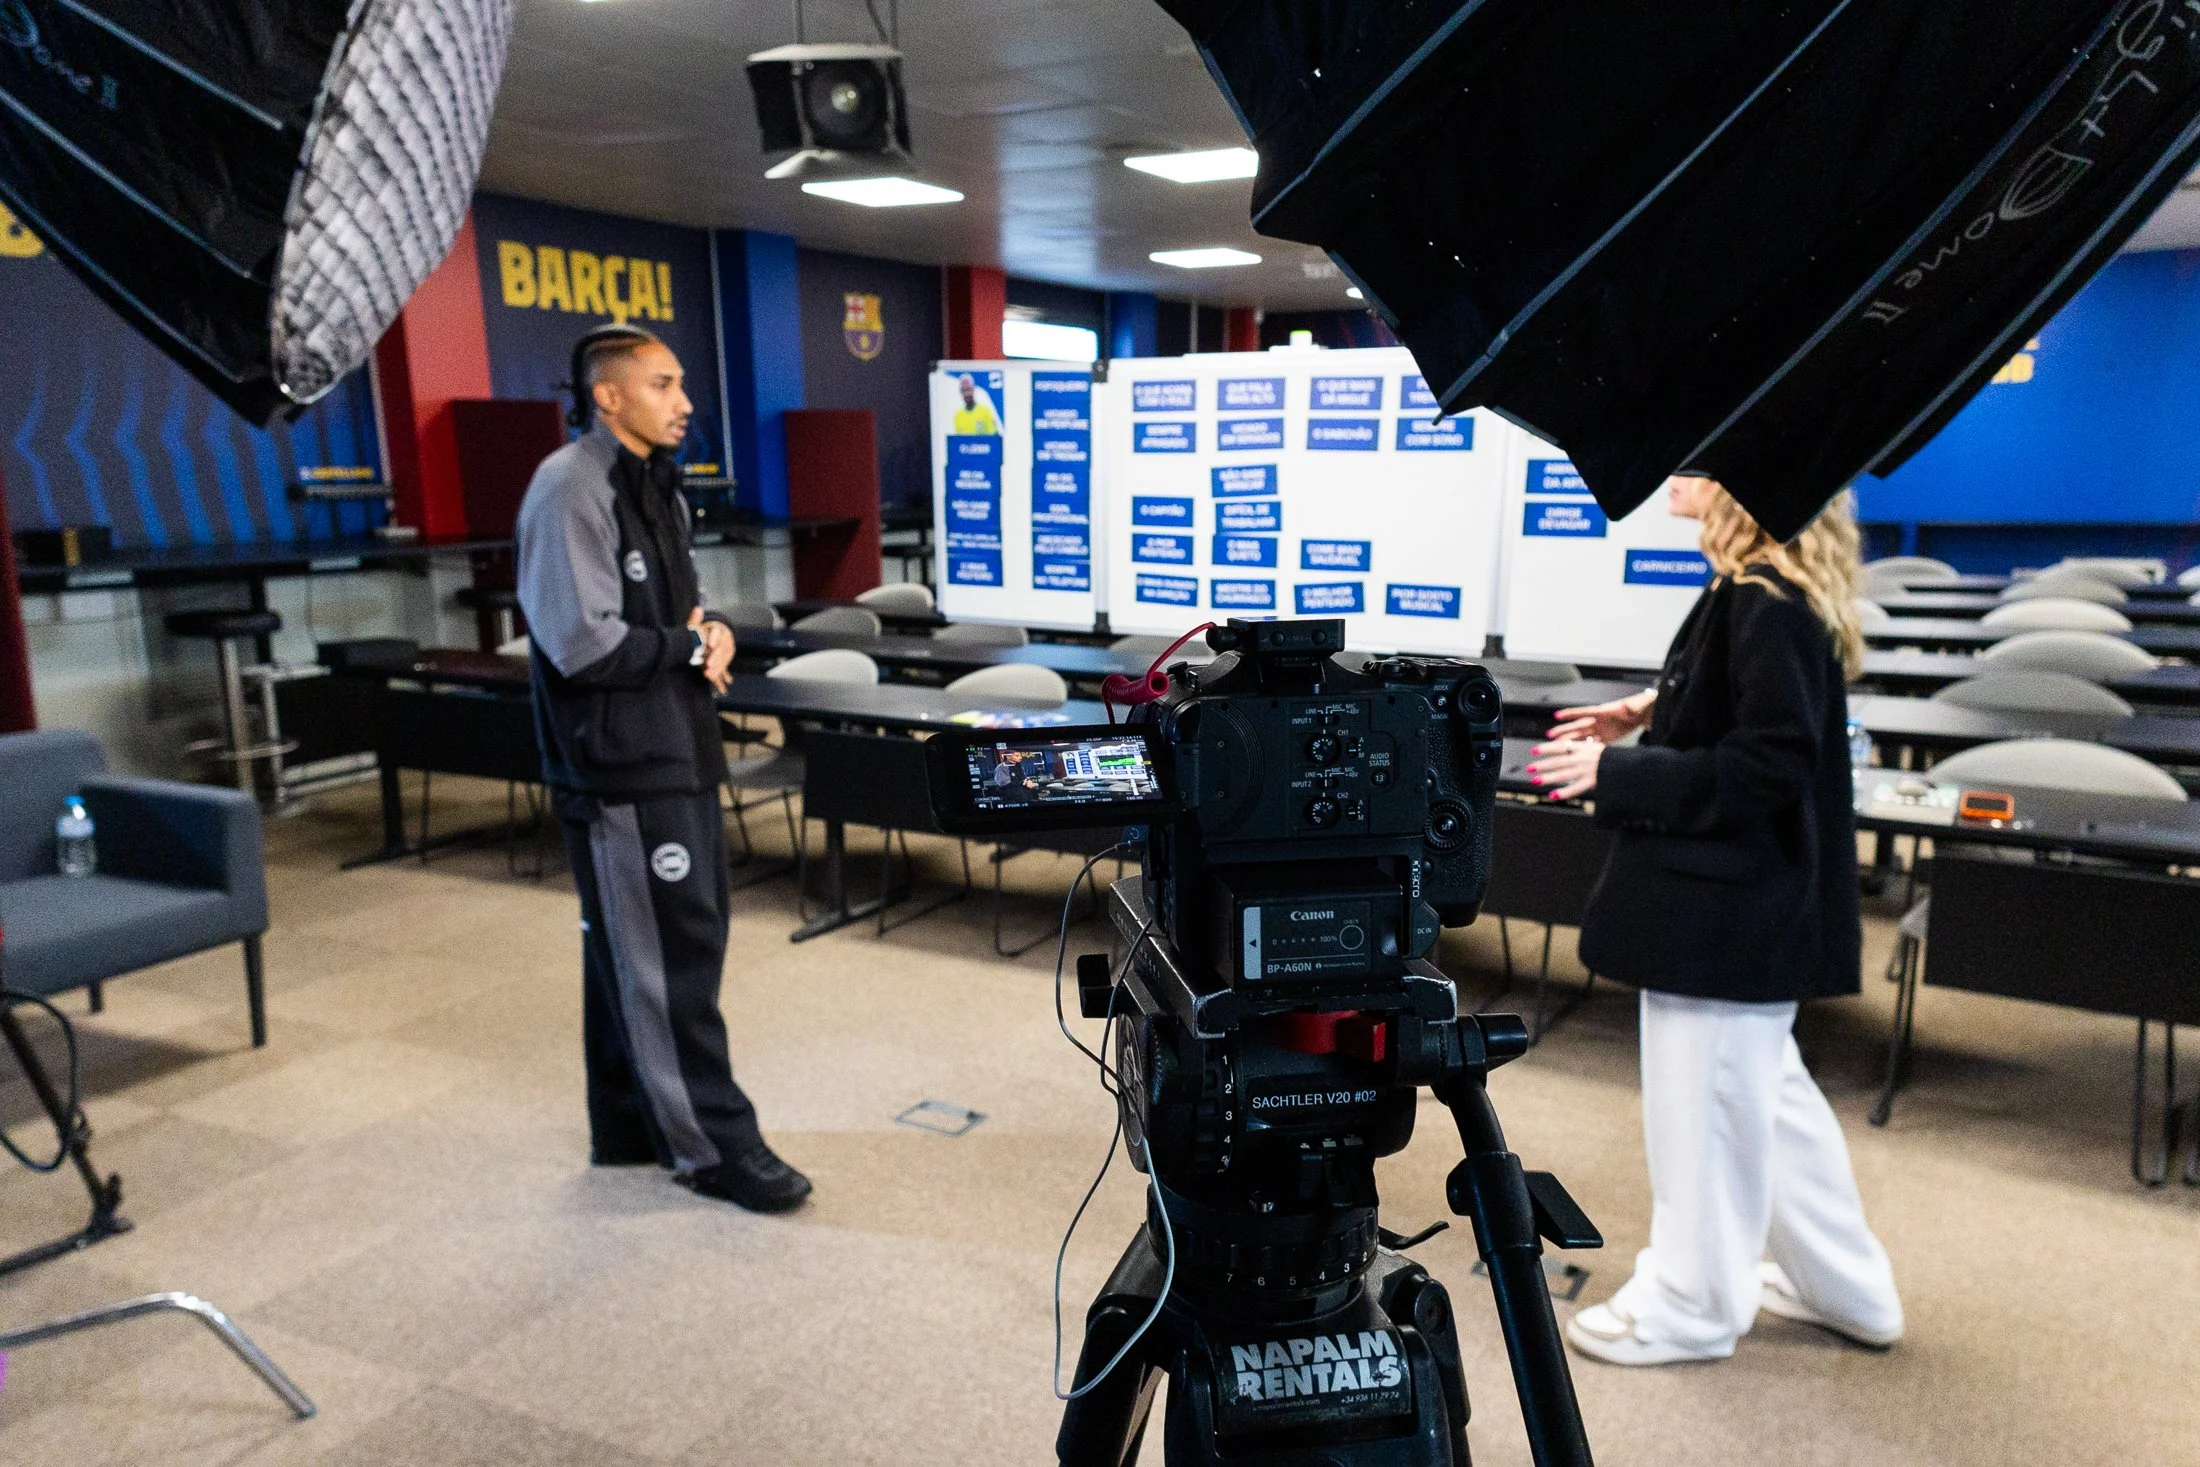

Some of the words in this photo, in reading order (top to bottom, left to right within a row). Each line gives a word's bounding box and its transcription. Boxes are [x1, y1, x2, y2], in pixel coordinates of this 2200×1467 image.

[498, 240, 674, 324] BARÇA!
[1291, 717, 1308, 725] INPUT
[1369, 752, 1390, 760] AUDIO
[1479, 752, 1487, 761] 9
[1369, 759, 1391, 767] STATUS
[1290, 910, 1335, 922] Canon
[1417, 927, 1425, 935] DC
[1267, 962, 1312, 974] BP-A60N
[1222, 1054, 1228, 1065] 1
[1225, 1083, 1232, 1094] 2
[1252, 1093, 1323, 1109] SACHTLER
[1326, 1092, 1351, 1104] V20
[1354, 1090, 1377, 1102] #02
[1225, 1111, 1233, 1121] 3
[1224, 1135, 1231, 1144] 4
[1343, 1262, 1350, 1273] 3
[1226, 1273, 1233, 1283] 7
[1257, 1276, 1265, 1286] 6
[1289, 1276, 1297, 1286] 5
[1319, 1271, 1326, 1281] 4
[1230, 1330, 1398, 1372] NAPALM
[1236, 1356, 1401, 1401] RENTALS
